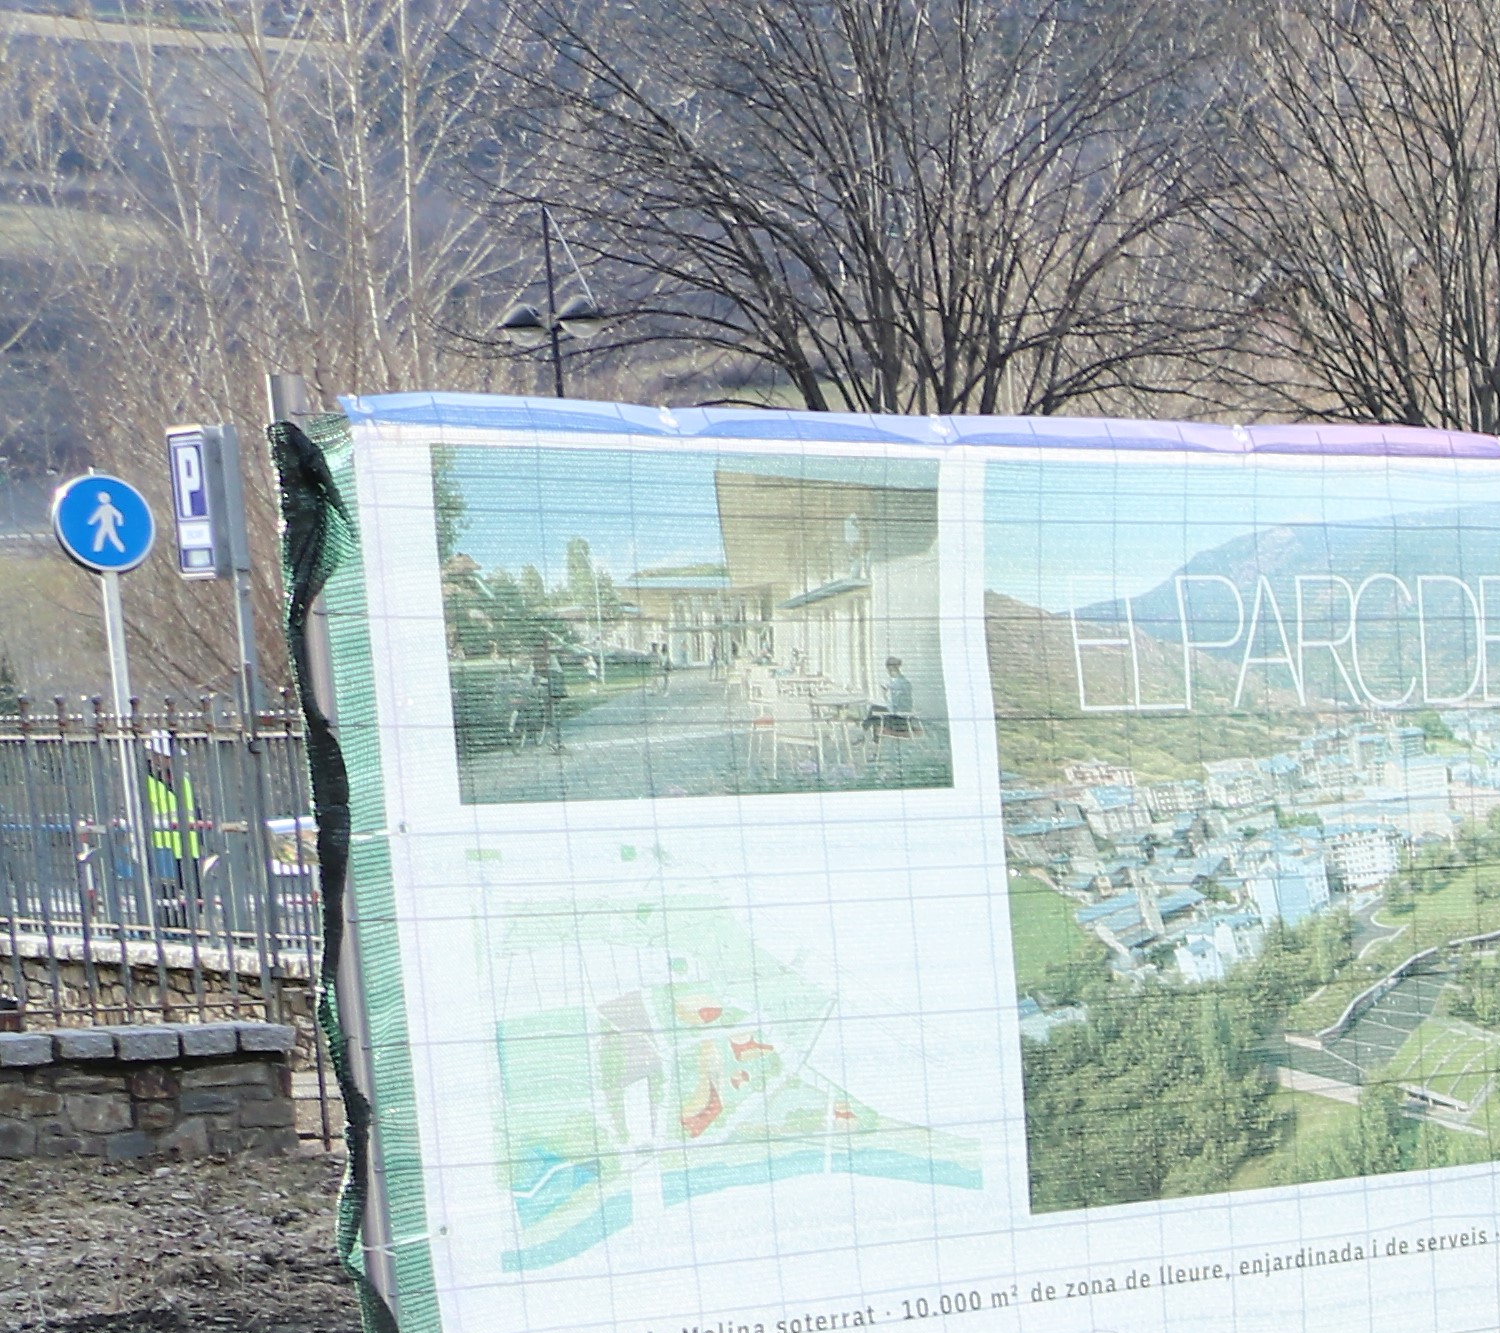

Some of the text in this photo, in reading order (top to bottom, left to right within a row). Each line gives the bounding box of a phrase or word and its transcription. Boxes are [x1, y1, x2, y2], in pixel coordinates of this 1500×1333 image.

[177, 446, 201, 517] P
[902, 1290, 982, 1321] 10.000
[1030, 1281, 1056, 1304] de
[1065, 1274, 1117, 1299] zona
[1125, 1268, 1151, 1292] de
[1159, 1258, 1231, 1286] lleure,
[1239, 1241, 1365, 1277] enjardinada
[1371, 1238, 1379, 1260] i
[1385, 1235, 1410, 1258] de
[1416, 1226, 1488, 1254] serveis
